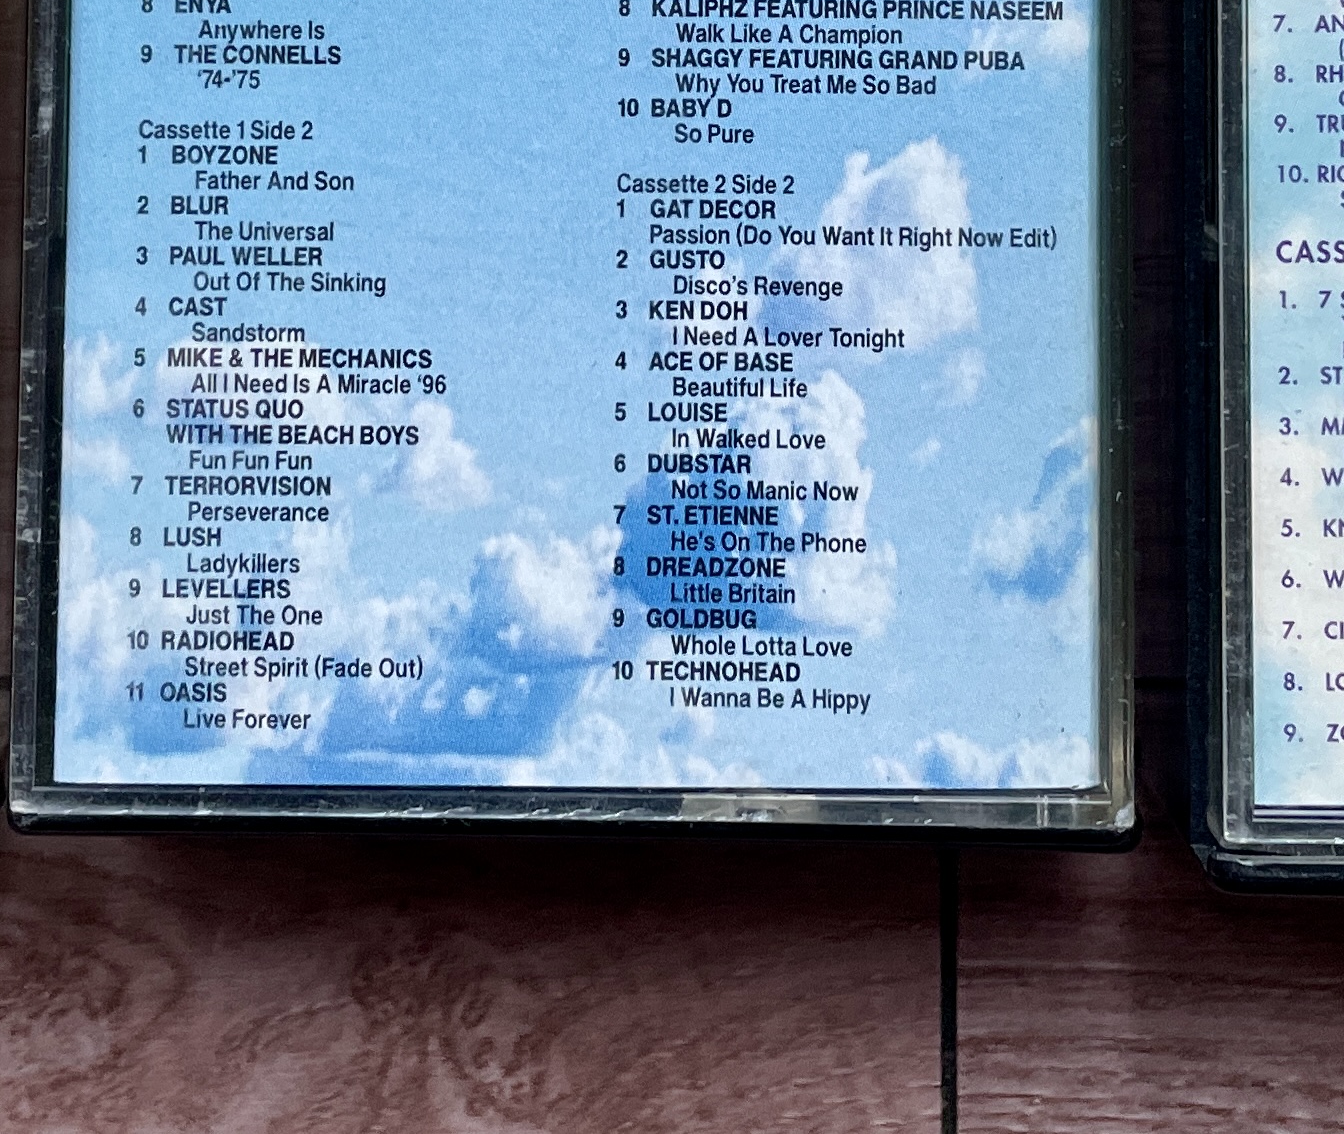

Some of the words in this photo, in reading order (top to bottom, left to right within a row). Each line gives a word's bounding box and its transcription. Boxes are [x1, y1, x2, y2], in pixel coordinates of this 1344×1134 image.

[754, 0, 877, 19] FEATURING
[884, 0, 964, 19] PRINCE
[971, 1, 1063, 20] NASEEM
[139, 120, 230, 139] Cassette
[236, 120, 245, 140] 1
[251, 120, 295, 140] Side
[302, 121, 313, 140] 2
[618, 173, 708, 193] Cassette
[715, 175, 726, 193] 2
[732, 174, 776, 194] Side
[783, 175, 794, 194] 2
[131, 476, 143, 494] 7
[165, 476, 331, 496] TERRORVISION
[189, 502, 329, 522] Perseverance
[671, 635, 735, 655] Whole
[743, 636, 796, 656] Lotta
[803, 636, 852, 656] Love
[612, 661, 633, 680] 10
[646, 661, 800, 682] TECHNOHEAD
[1284, 724, 1303, 742] 9.
